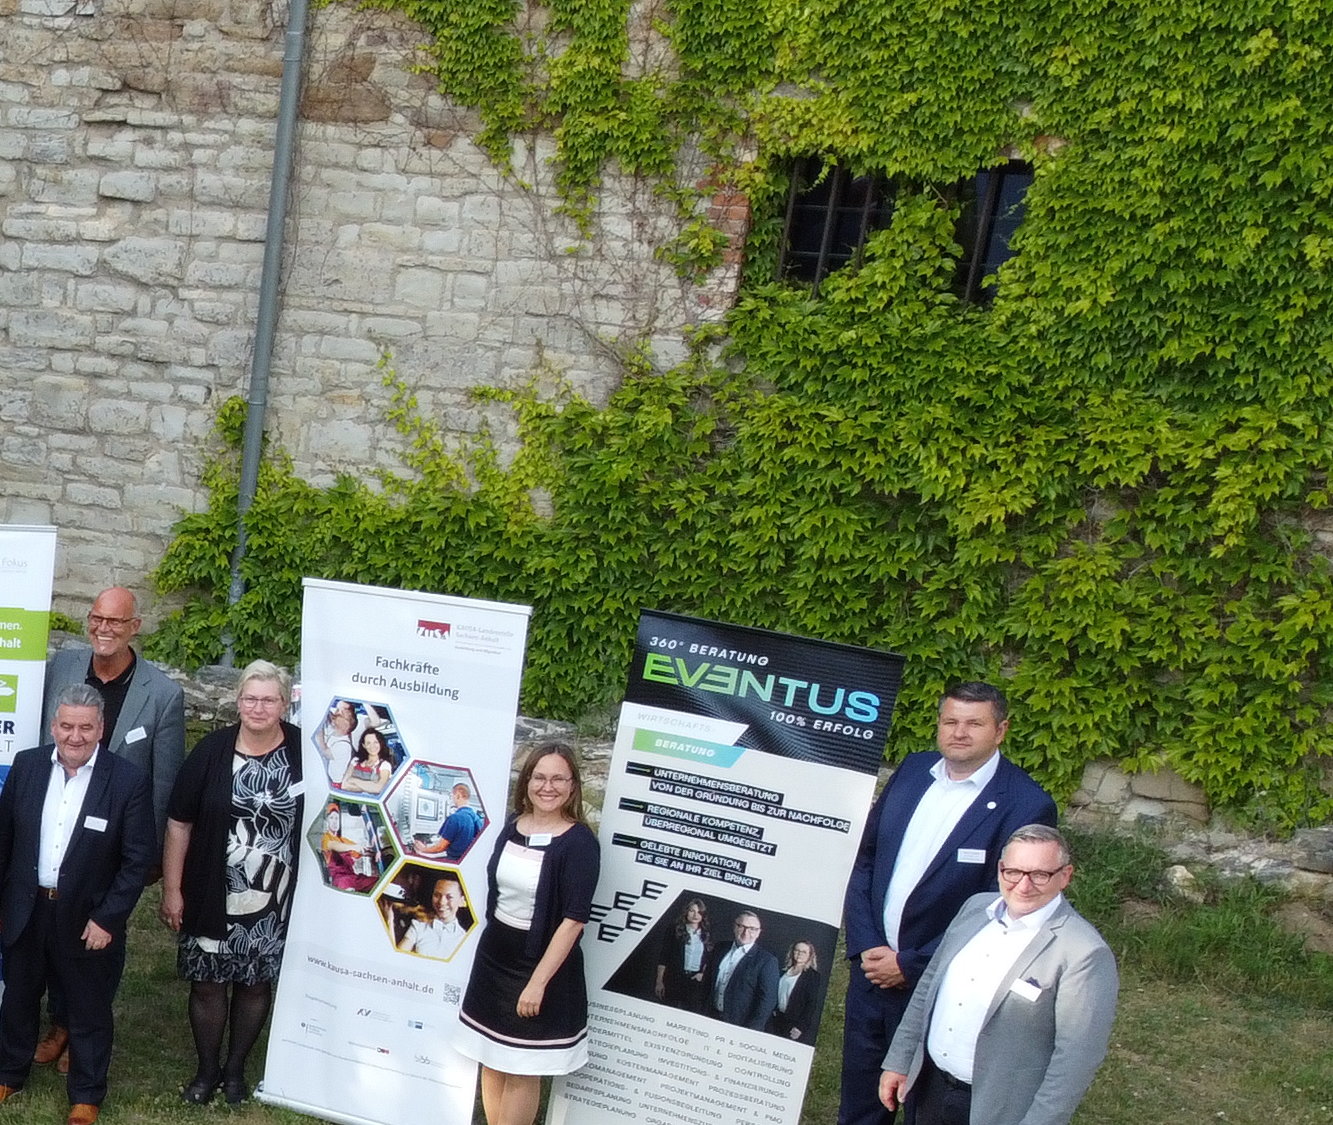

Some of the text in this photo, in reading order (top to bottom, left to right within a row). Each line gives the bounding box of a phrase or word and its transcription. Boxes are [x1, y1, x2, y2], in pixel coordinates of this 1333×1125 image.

[375, 655, 440, 676] Fachkräfte
[689, 643, 769, 666] BERATUNG
[351, 672, 460, 701] durch Ausbildung
[642, 652, 880, 723] EVENTUS
[770, 710, 874, 740] 100% ERFOLG
[654, 738, 716, 758] BERATUNG
[653, 768, 780, 803] UNTERNEHMENSBERATUNG
[646, 804, 761, 838] REGIONALE KOMPETENZ,
[651, 781, 850, 832] VON DER GRÜNDUNG BIS ZUR NACHFOLGE
[639, 841, 681, 857] GELEBTE
[644, 817, 773, 854] ÜBERREGIONAL UMGESETZT
[637, 852, 759, 888] DIE SIE AN IHR ZIEL BRINGT
[307, 954, 434, 995] www.kausa-sachsen-anhalt.de
